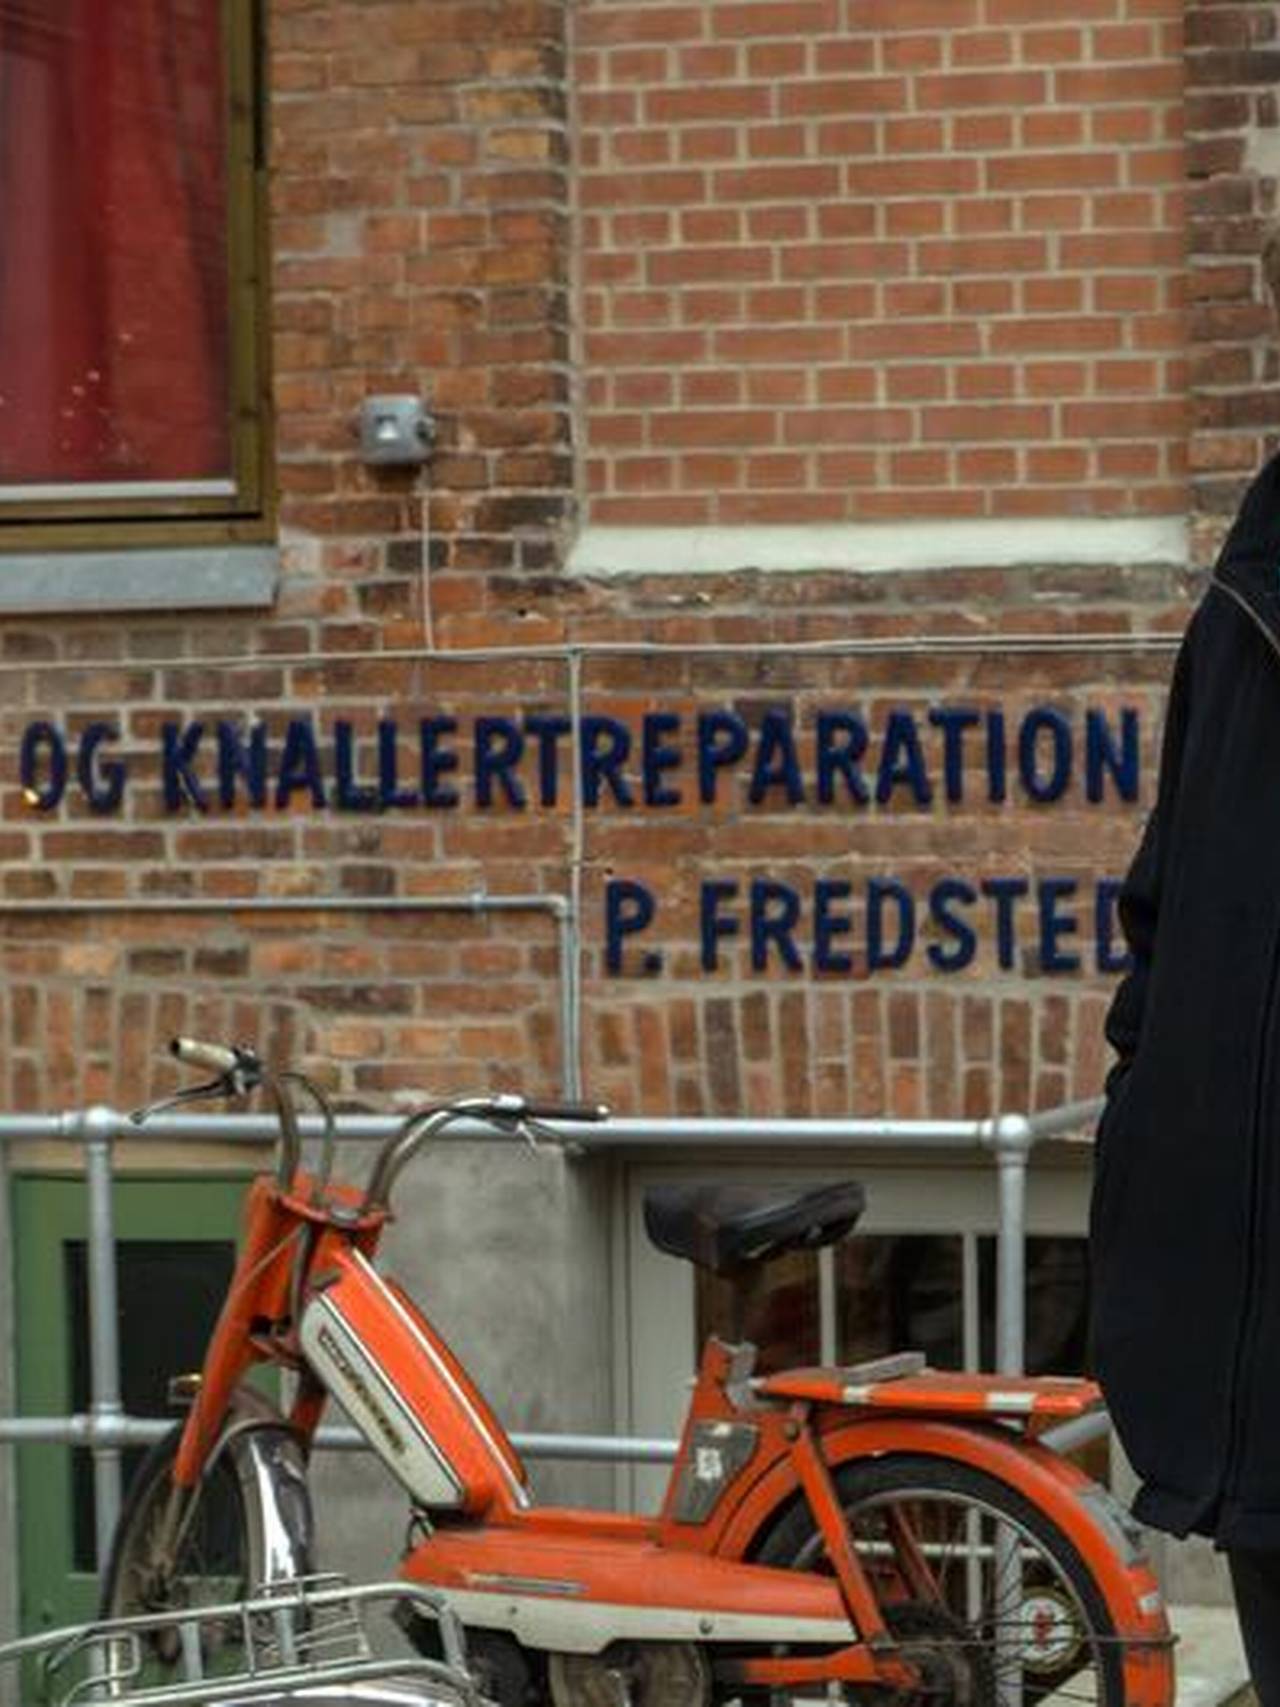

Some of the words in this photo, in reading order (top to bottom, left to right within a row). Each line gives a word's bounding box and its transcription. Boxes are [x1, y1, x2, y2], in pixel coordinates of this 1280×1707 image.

[20, 719, 127, 813] OG
[162, 708, 1140, 811] KNALLERTREPARATION
[605, 878, 663, 975] P.
